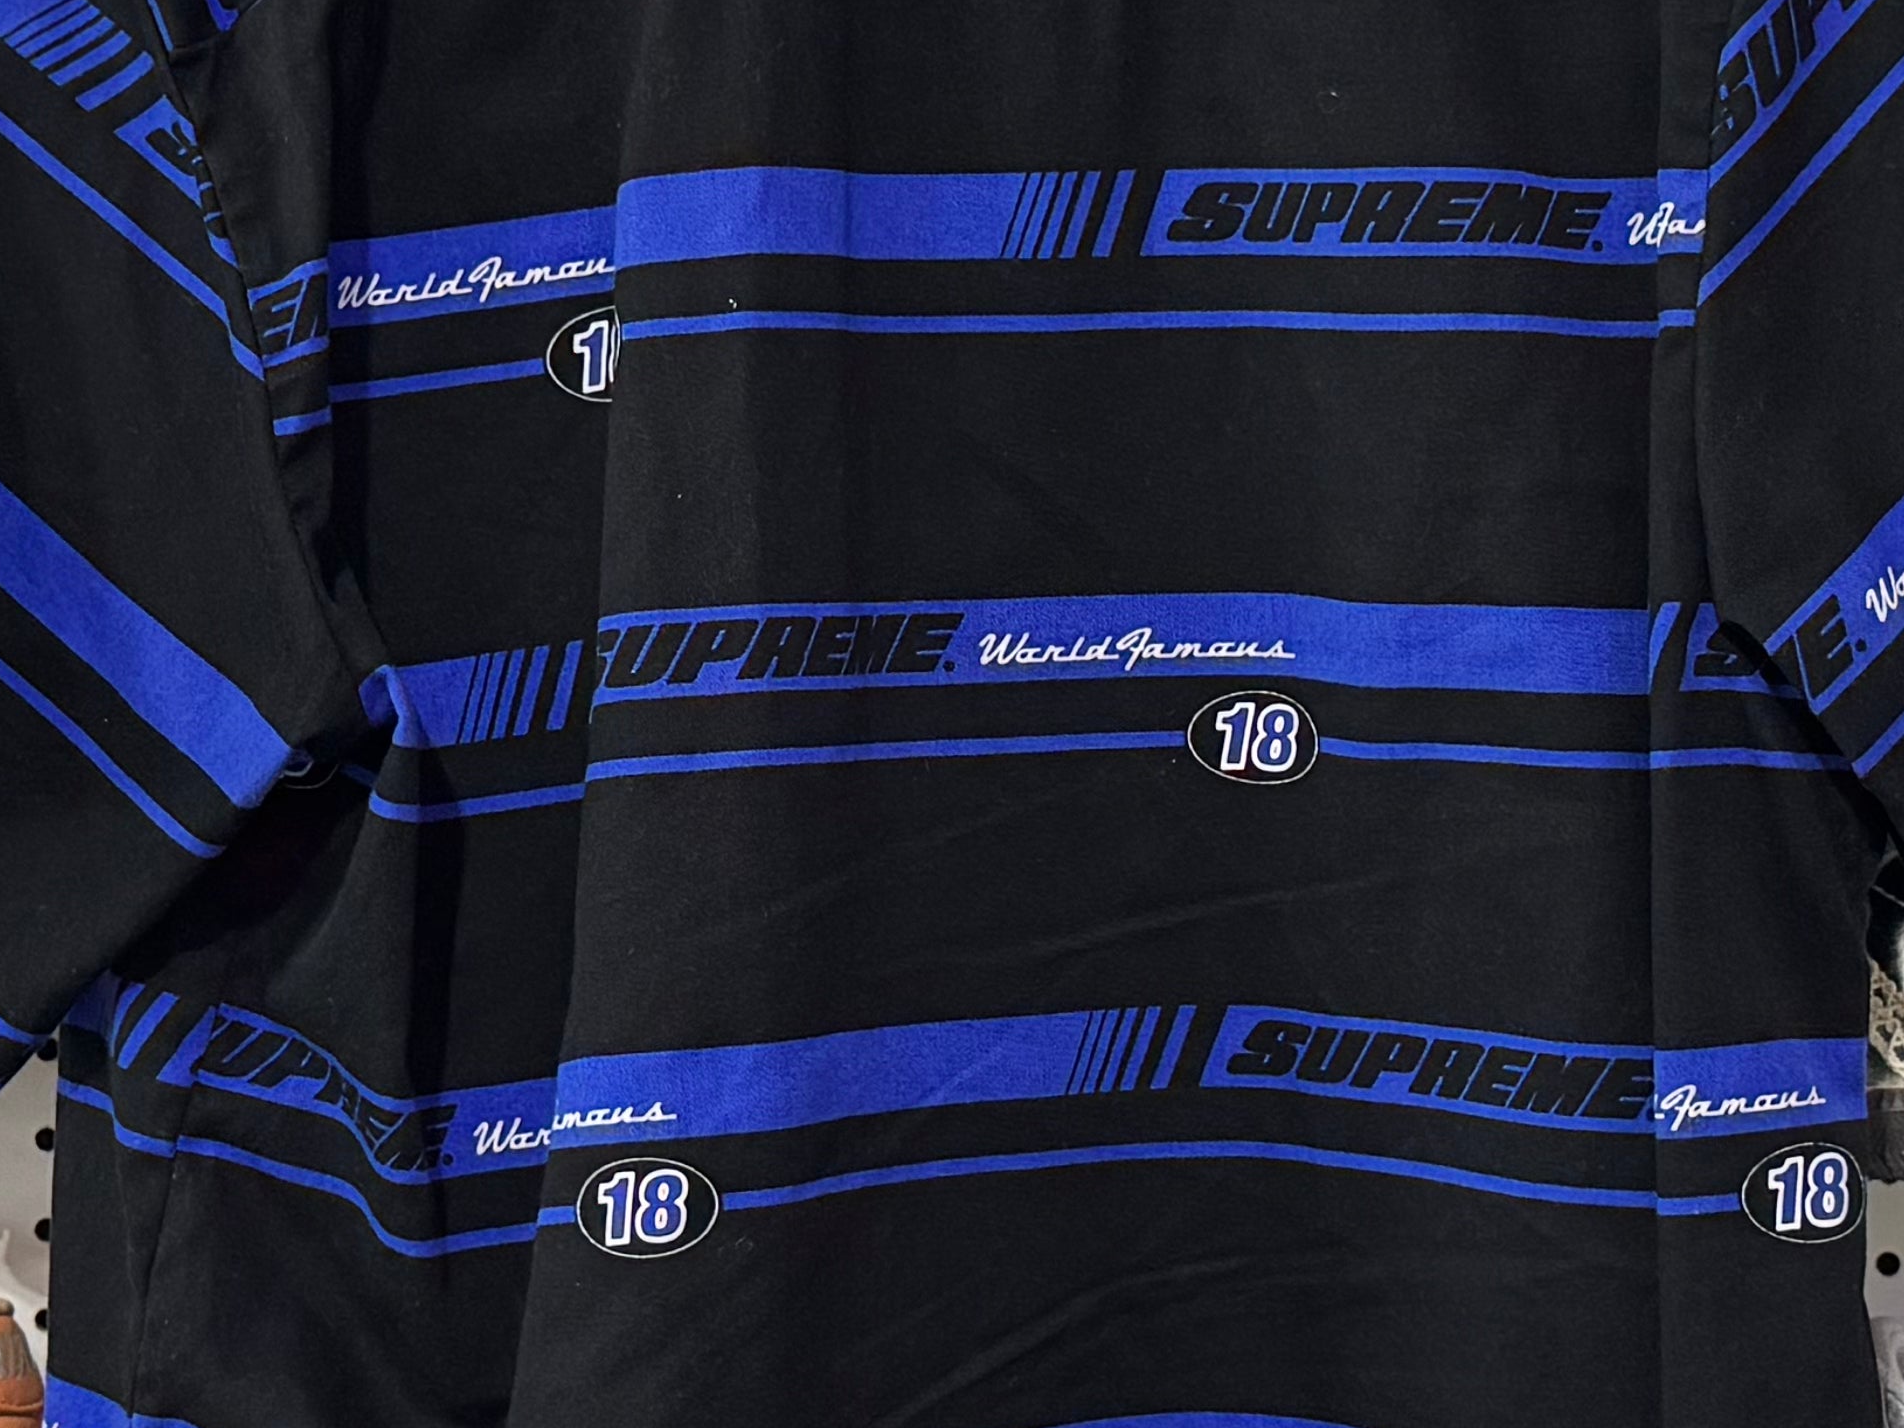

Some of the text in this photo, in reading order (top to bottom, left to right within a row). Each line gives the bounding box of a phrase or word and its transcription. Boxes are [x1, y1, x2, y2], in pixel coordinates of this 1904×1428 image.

[338, 272, 471, 310] World
[979, 631, 1118, 668] World
[1115, 627, 1295, 672] Famous
[1216, 701, 1299, 771] 18
[598, 1171, 687, 1247] 18
[1768, 1154, 1849, 1232] 18
